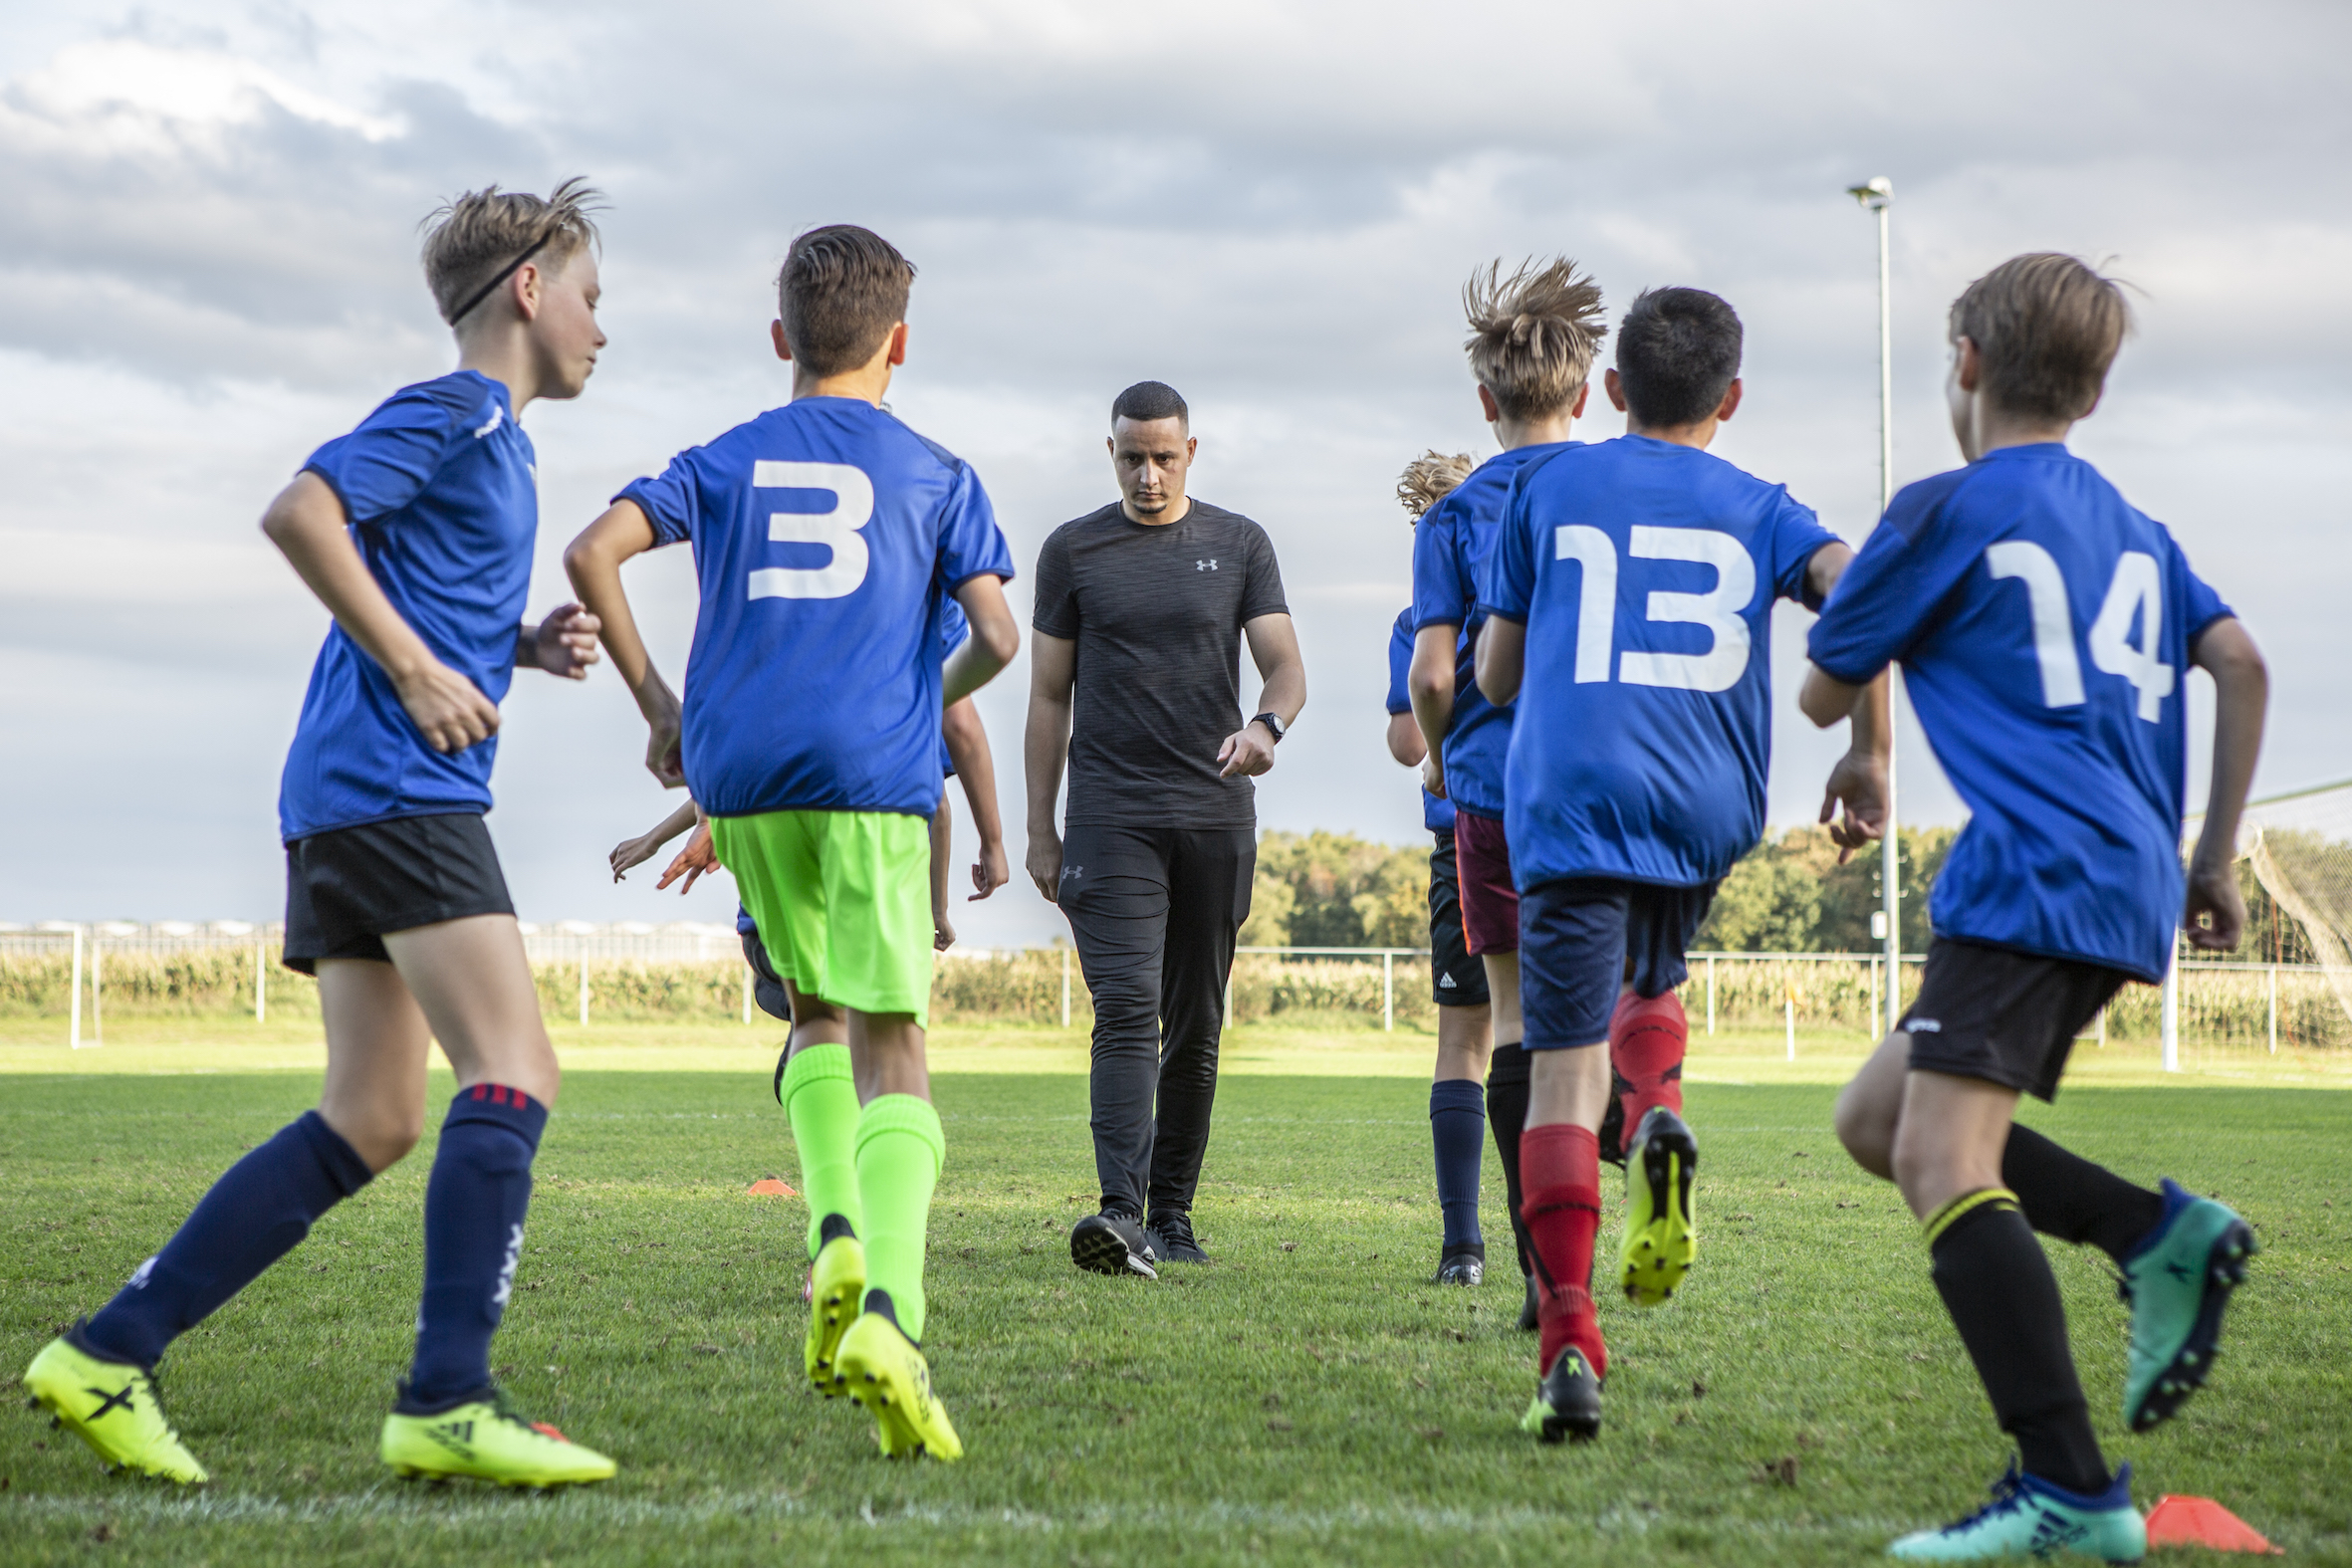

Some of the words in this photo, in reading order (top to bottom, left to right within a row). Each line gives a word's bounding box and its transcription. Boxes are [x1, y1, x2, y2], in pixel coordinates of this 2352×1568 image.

[748, 459, 874, 601] 3
[1555, 524, 1757, 693] 13
[1987, 539, 2175, 724] 14
